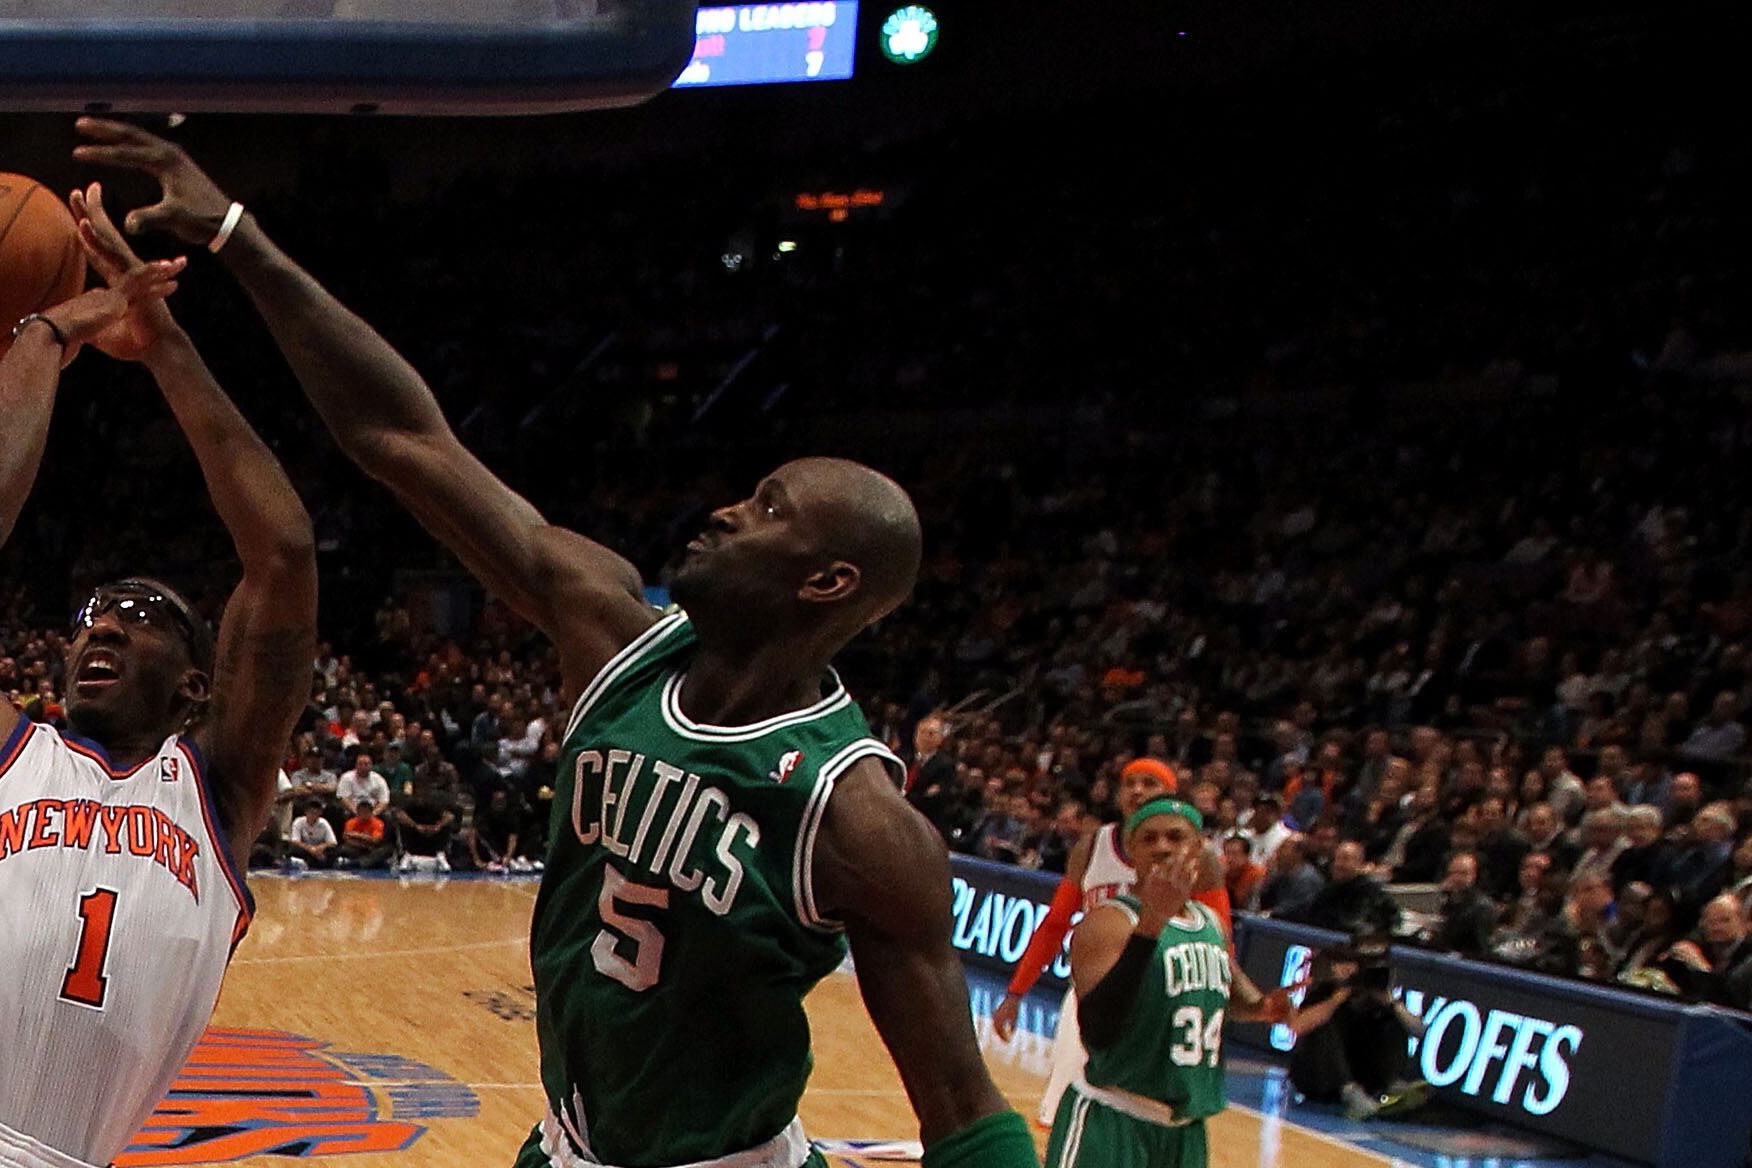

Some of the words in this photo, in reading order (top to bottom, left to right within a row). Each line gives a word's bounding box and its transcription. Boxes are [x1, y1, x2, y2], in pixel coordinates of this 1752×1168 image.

[98, 805, 201, 906] YORK
[572, 749, 761, 917] CELTICS
[56, 885, 119, 1012] 1
[590, 862, 669, 992] 5
[1169, 1005, 1226, 1068] 34
